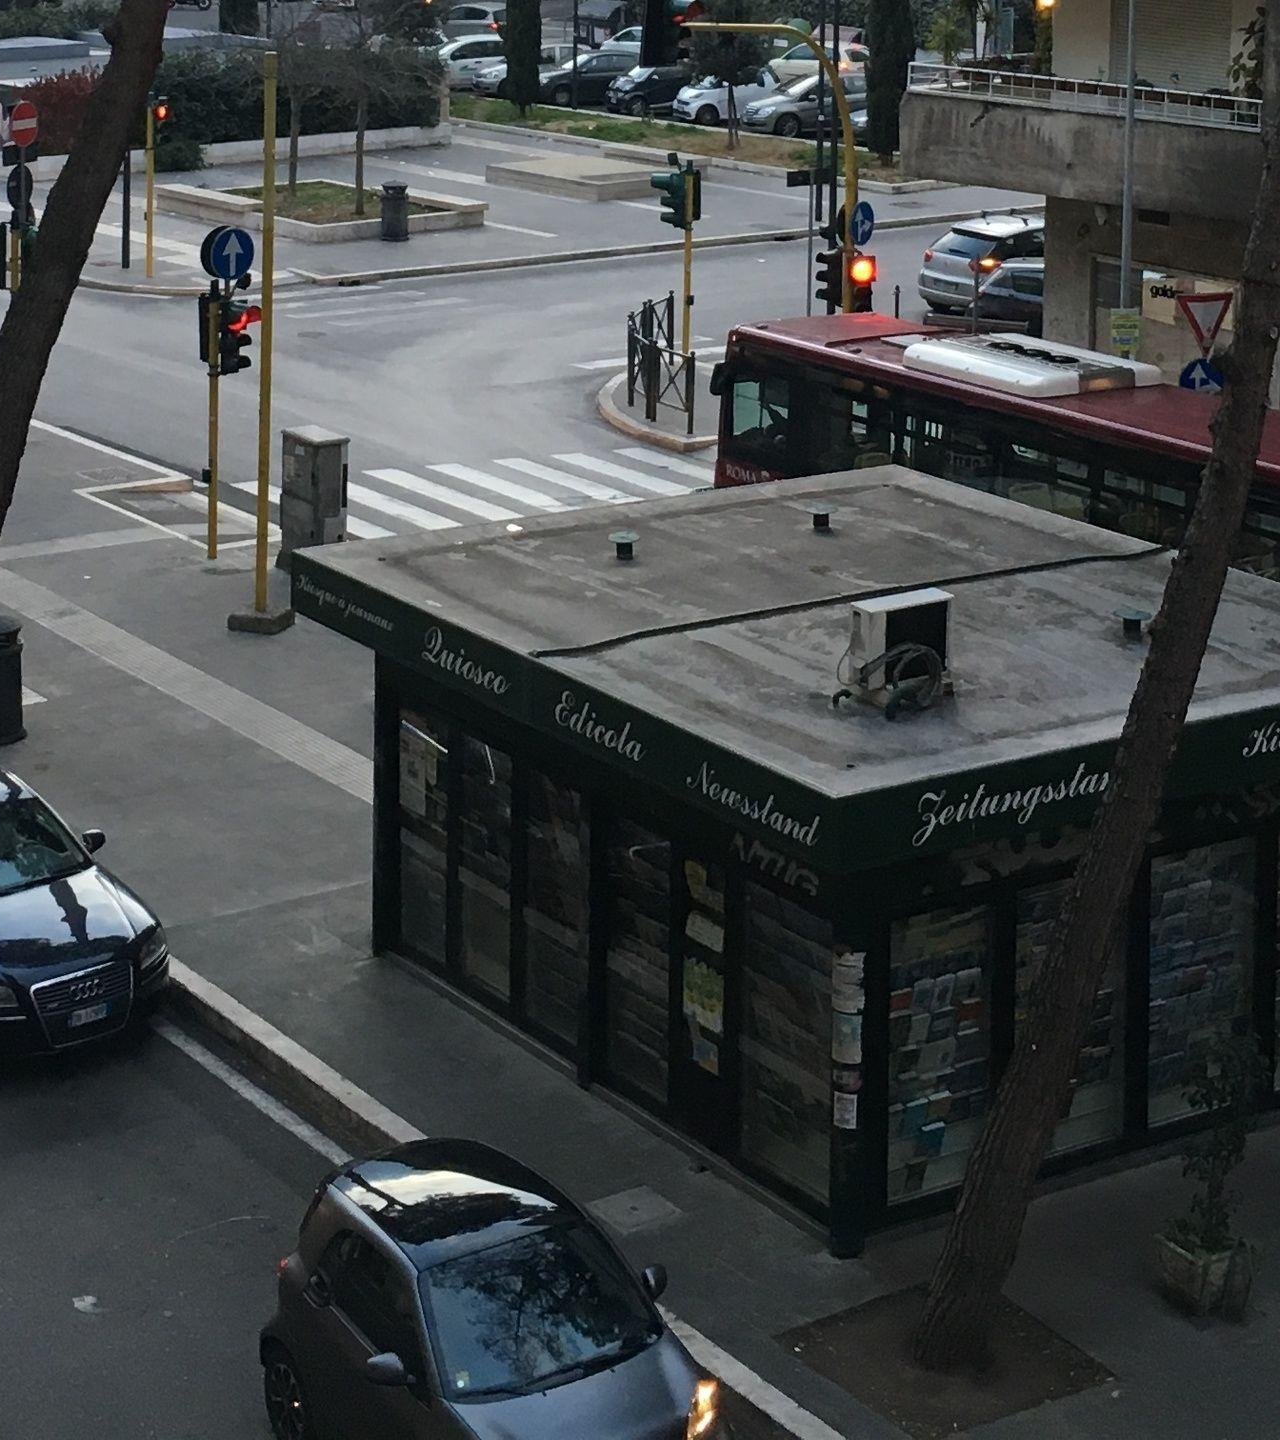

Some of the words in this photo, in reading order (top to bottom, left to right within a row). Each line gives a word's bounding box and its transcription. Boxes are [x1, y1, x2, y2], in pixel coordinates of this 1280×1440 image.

[421, 625, 512, 696] Quiosco
[554, 690, 647, 762] Edicola
[686, 761, 820, 847] Newsstand
